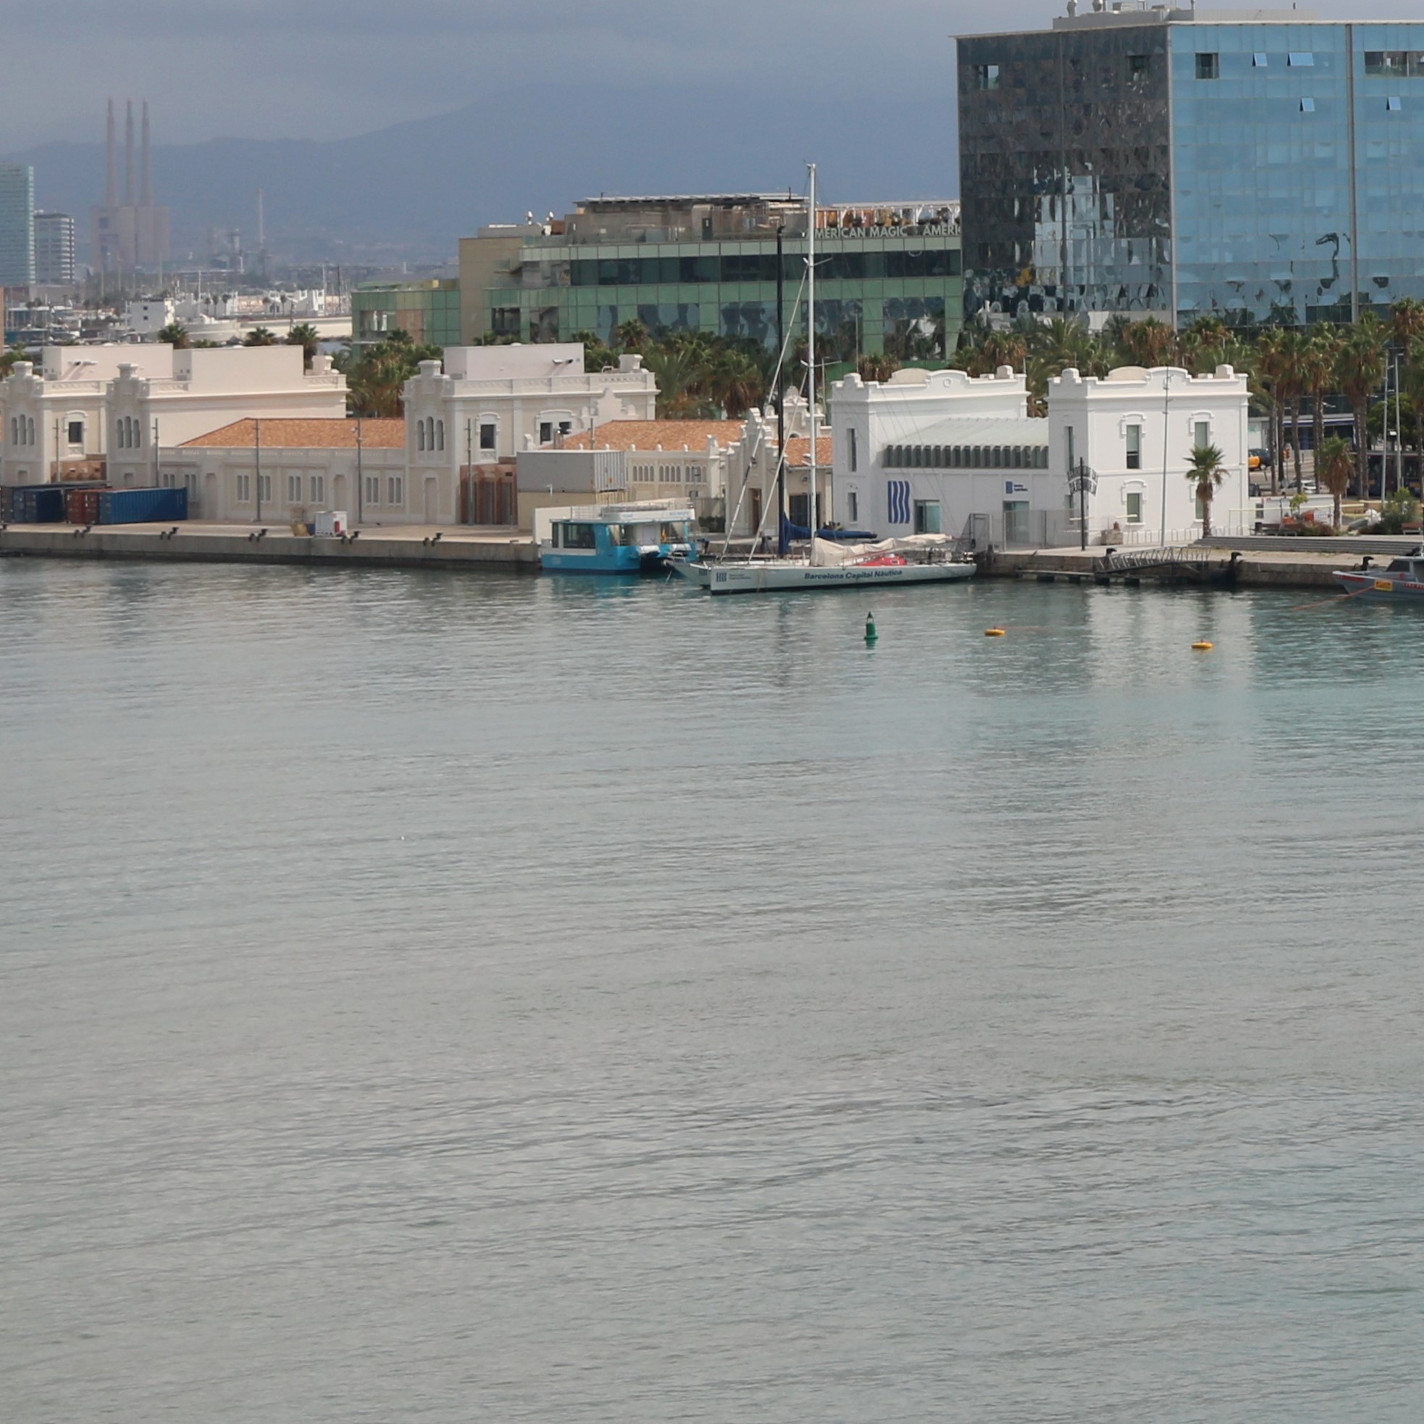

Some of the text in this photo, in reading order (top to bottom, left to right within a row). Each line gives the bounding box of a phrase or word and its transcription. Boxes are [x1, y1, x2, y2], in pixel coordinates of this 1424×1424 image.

[869, 225, 908, 238] MAGIC
[804, 572, 844, 580] Barcelona
[845, 571, 873, 580] Capital
